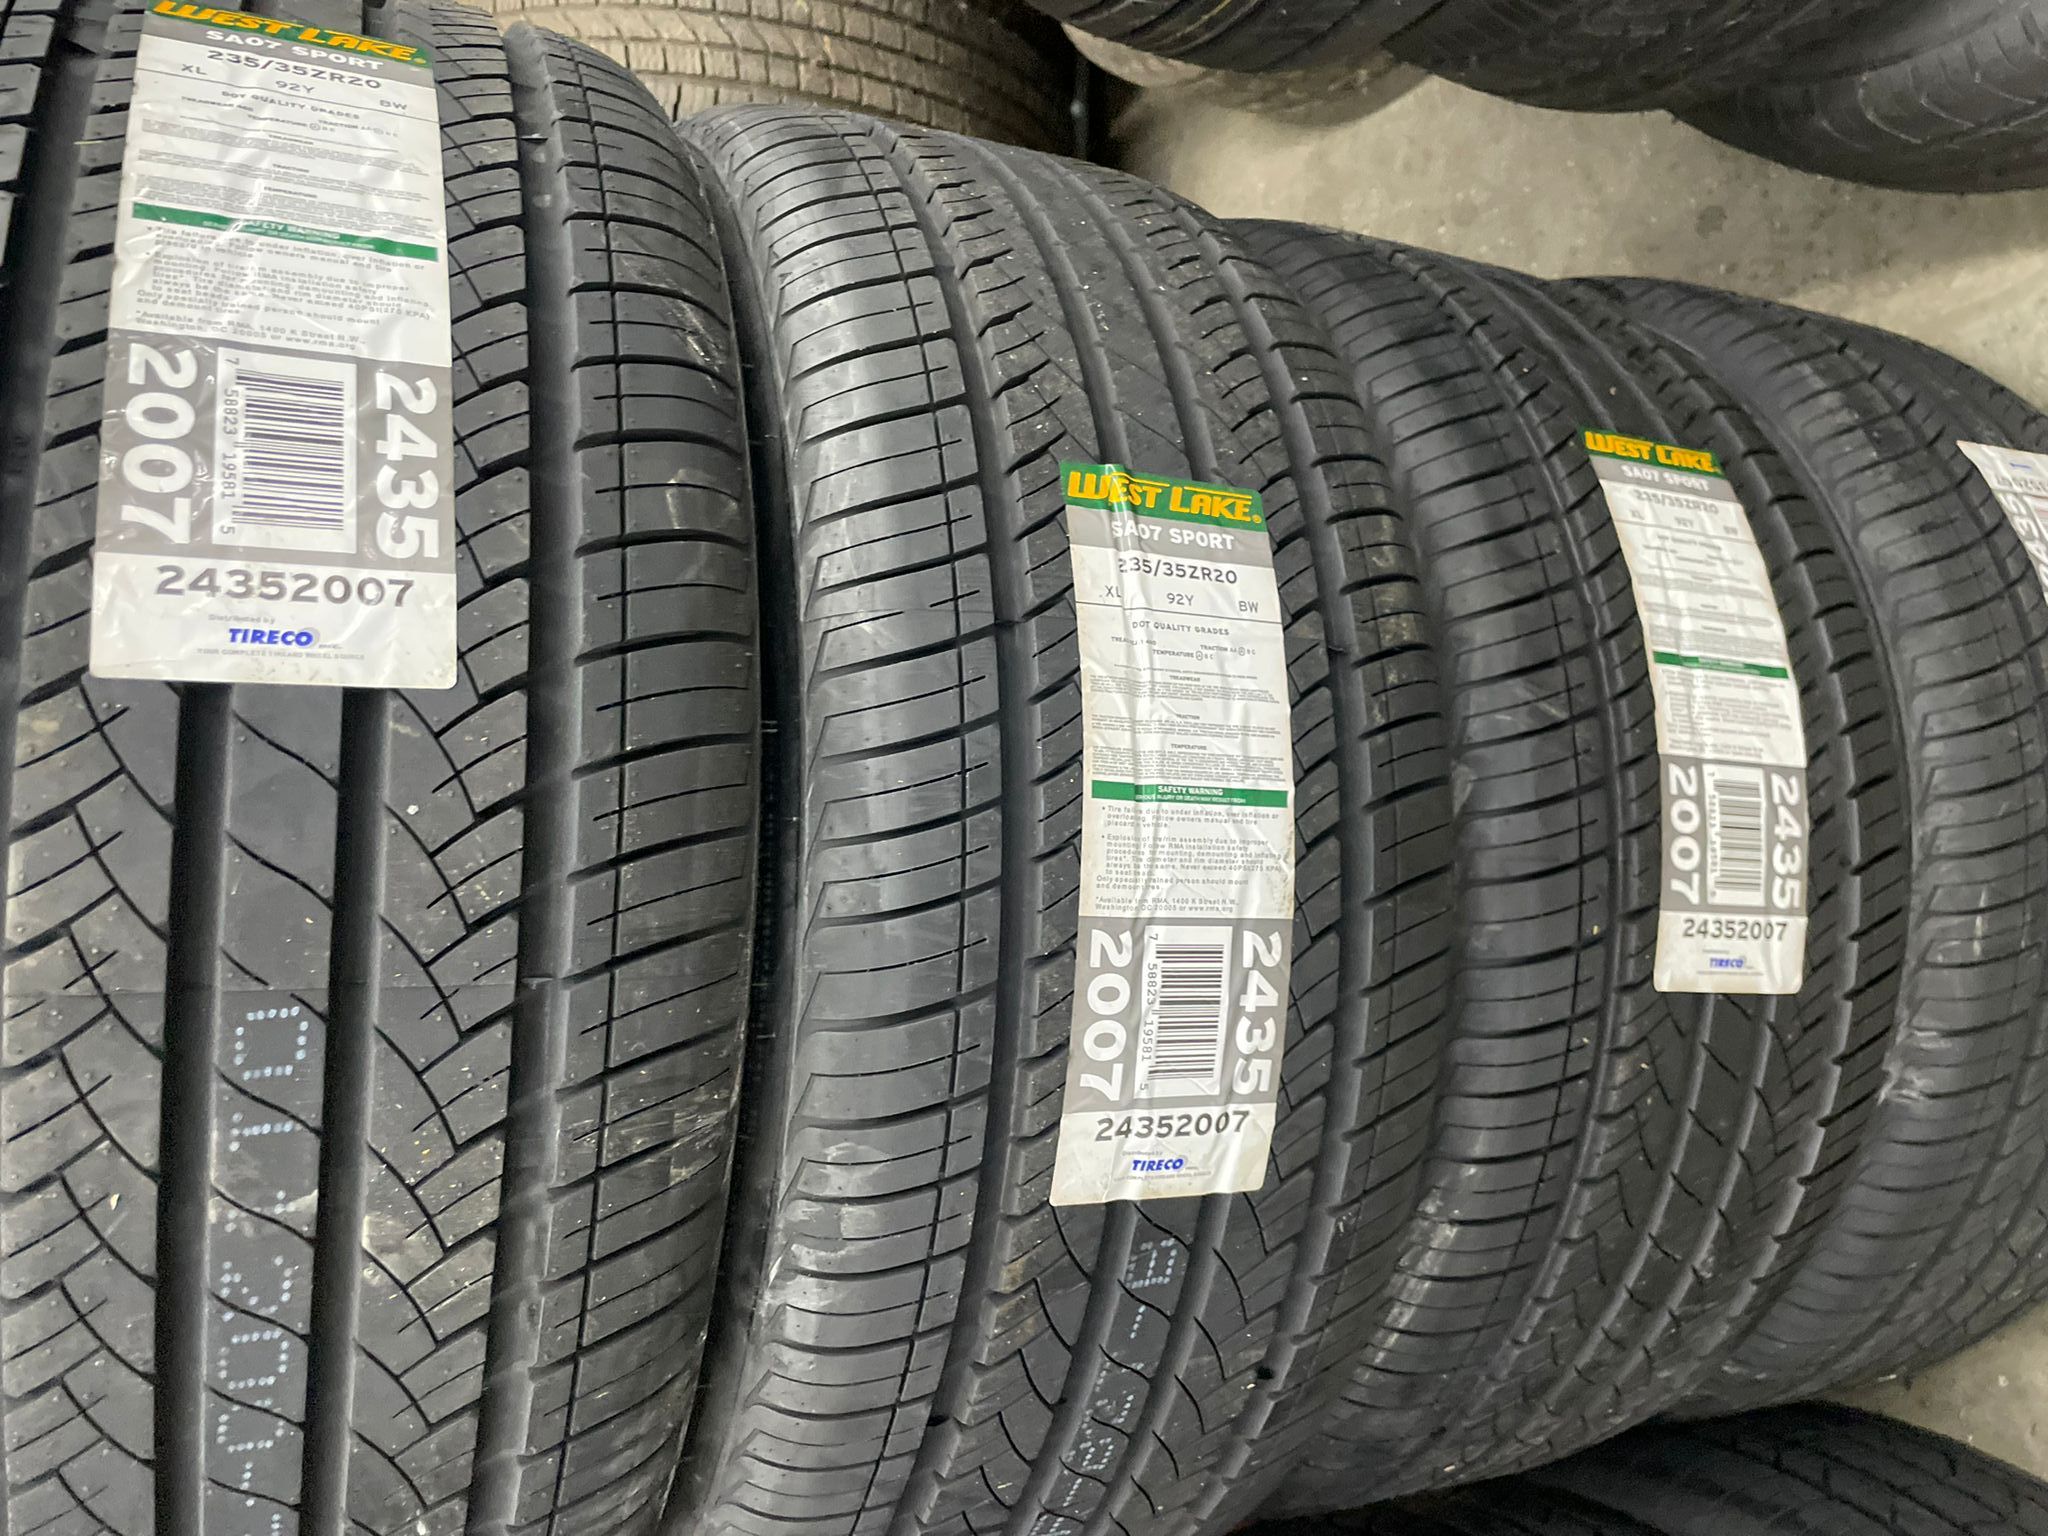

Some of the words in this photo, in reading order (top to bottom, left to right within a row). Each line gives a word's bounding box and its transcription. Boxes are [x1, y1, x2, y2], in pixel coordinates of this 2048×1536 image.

[154, 2, 292, 34] WEST
[298, 27, 418, 62] LAKE
[182, 64, 207, 76] XL
[207, 50, 382, 90] 235/35ZR20
[292, 46, 384, 71] SPORT
[275, 80, 315, 94] 92Y
[251, 94, 306, 110] QUALITY
[379, 99, 408, 111] BW
[225, 356, 240, 365] 7
[222, 387, 241, 438] 58823
[120, 342, 199, 546] 2007
[1585, 431, 1654, 460] WEST
[1656, 445, 1715, 473] LAKE
[220, 452, 238, 501] 19581
[375, 369, 440, 560] 2435
[1663, 474, 1711, 492] SPORT
[1067, 470, 1164, 509] WEST
[1169, 487, 1253, 522] LAKE
[219, 525, 235, 536] 5
[1111, 520, 1163, 541] SA07
[1170, 528, 1235, 550] SPORT
[1118, 557, 1238, 585] 235/35ZR20
[156, 564, 415, 608] 24352007
[1105, 585, 1122, 598] XL
[1166, 592, 1194, 607] 92Y
[1238, 600, 1259, 613] BW
[229, 628, 314, 648] TIRECO
[1132, 620, 1151, 629] DOT
[1153, 621, 1191, 633] QUALITY
[1194, 625, 1230, 636] GRADES
[1152, 648, 1195, 659] TEMPERATURE
[1158, 785, 1188, 794] SAFETY
[1188, 787, 1223, 796] WARNING
[1668, 762, 1701, 905] 2007
[1771, 772, 1803, 909] 2435
[1148, 933, 1158, 941] 7
[1682, 918, 1788, 941] 24352007
[1146, 963, 1158, 1006] 58823
[1080, 928, 1133, 1101] 2007
[1232, 930, 1283, 1095] 2435
[1141, 1019, 1154, 1062] 19581
[1139, 1083, 1147, 1091] 5
[1095, 1110, 1250, 1142] 24352007
[1132, 1158, 1184, 1171] TIRECO
